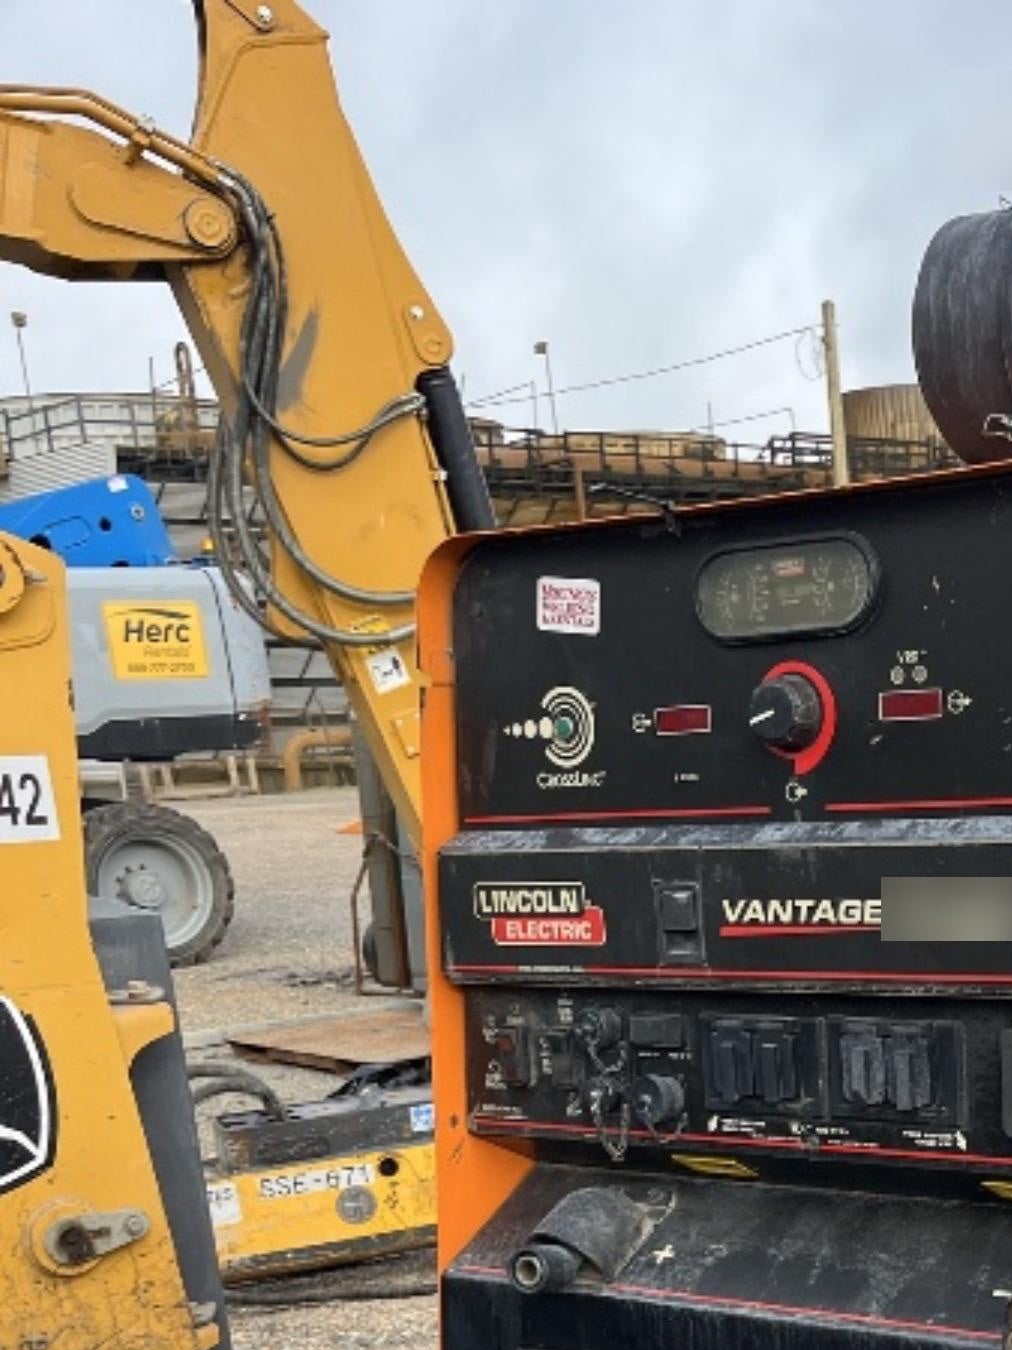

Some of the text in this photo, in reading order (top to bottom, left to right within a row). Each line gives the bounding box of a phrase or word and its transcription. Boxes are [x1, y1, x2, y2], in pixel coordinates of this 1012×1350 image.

[124, 619, 190, 643] Herc
[0, 773, 48, 826] 42
[479, 889, 581, 914] LINCOLN
[722, 899, 881, 925] VANTAGE
[506, 920, 593, 940] ELECTRIC
